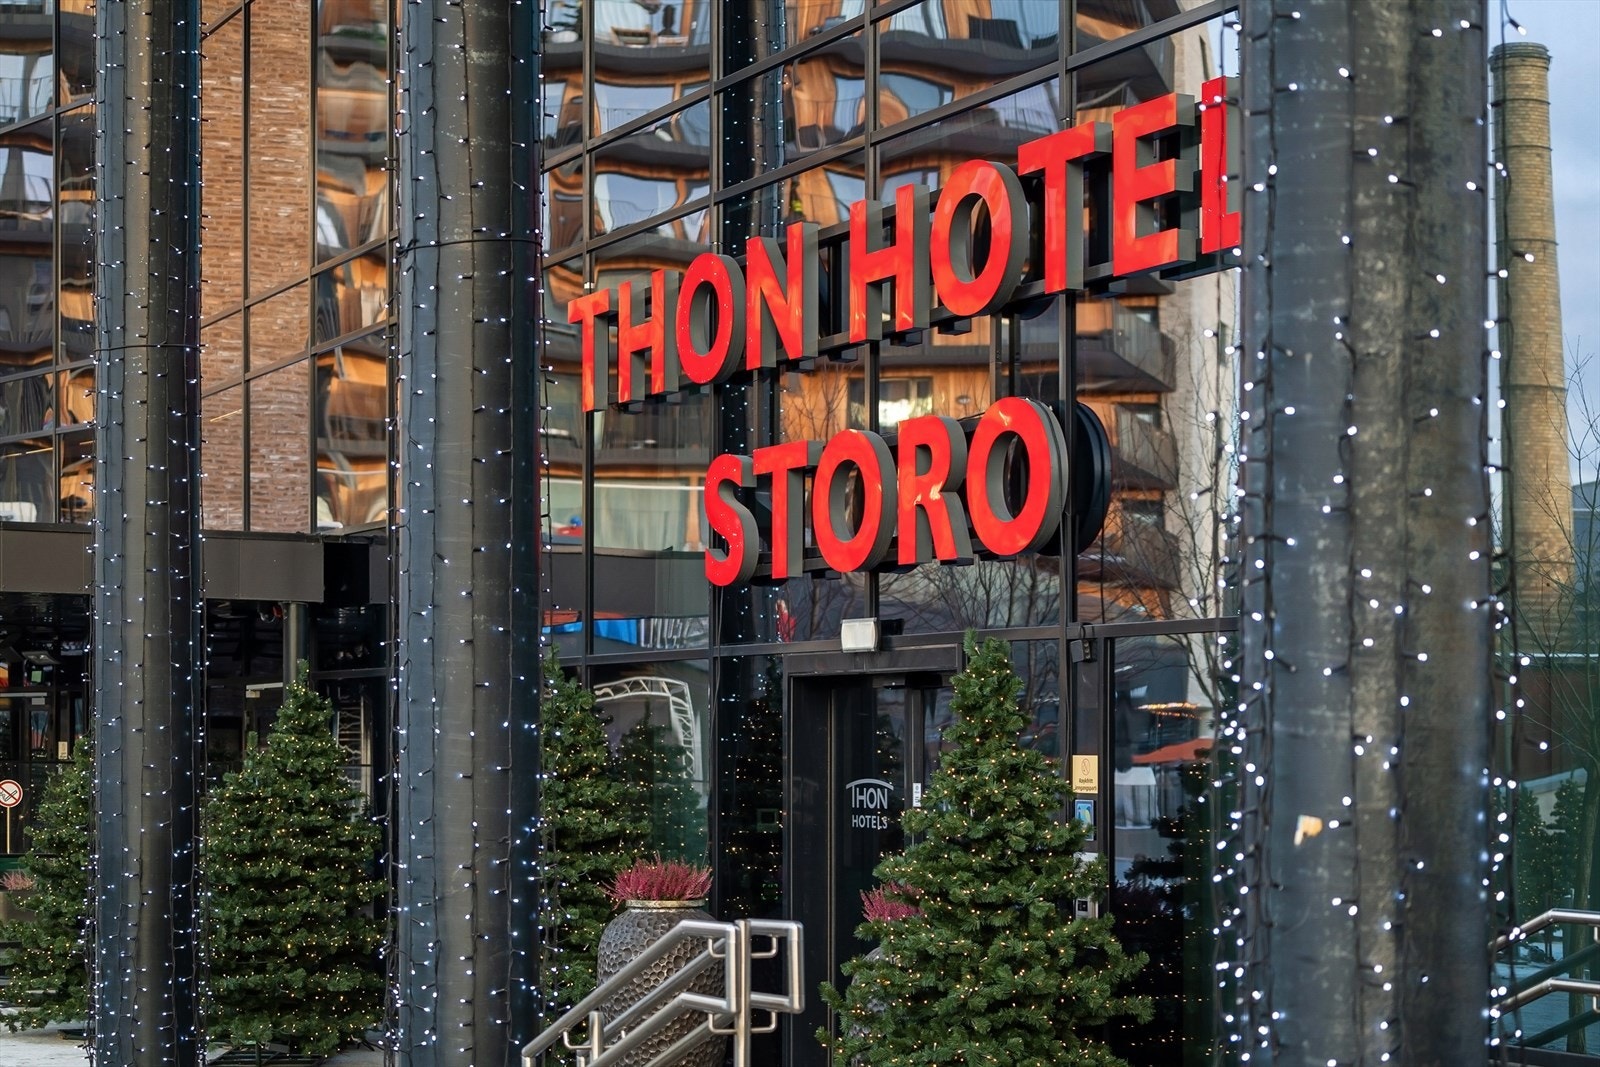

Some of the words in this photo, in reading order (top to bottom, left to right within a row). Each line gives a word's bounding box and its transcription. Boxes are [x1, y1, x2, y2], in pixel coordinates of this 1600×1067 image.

[568, 222, 808, 412] THON
[850, 76, 1240, 343] HOTEL
[704, 397, 1058, 586] STORO
[846, 778, 894, 809] THON
[851, 815, 888, 830] HOTELS
